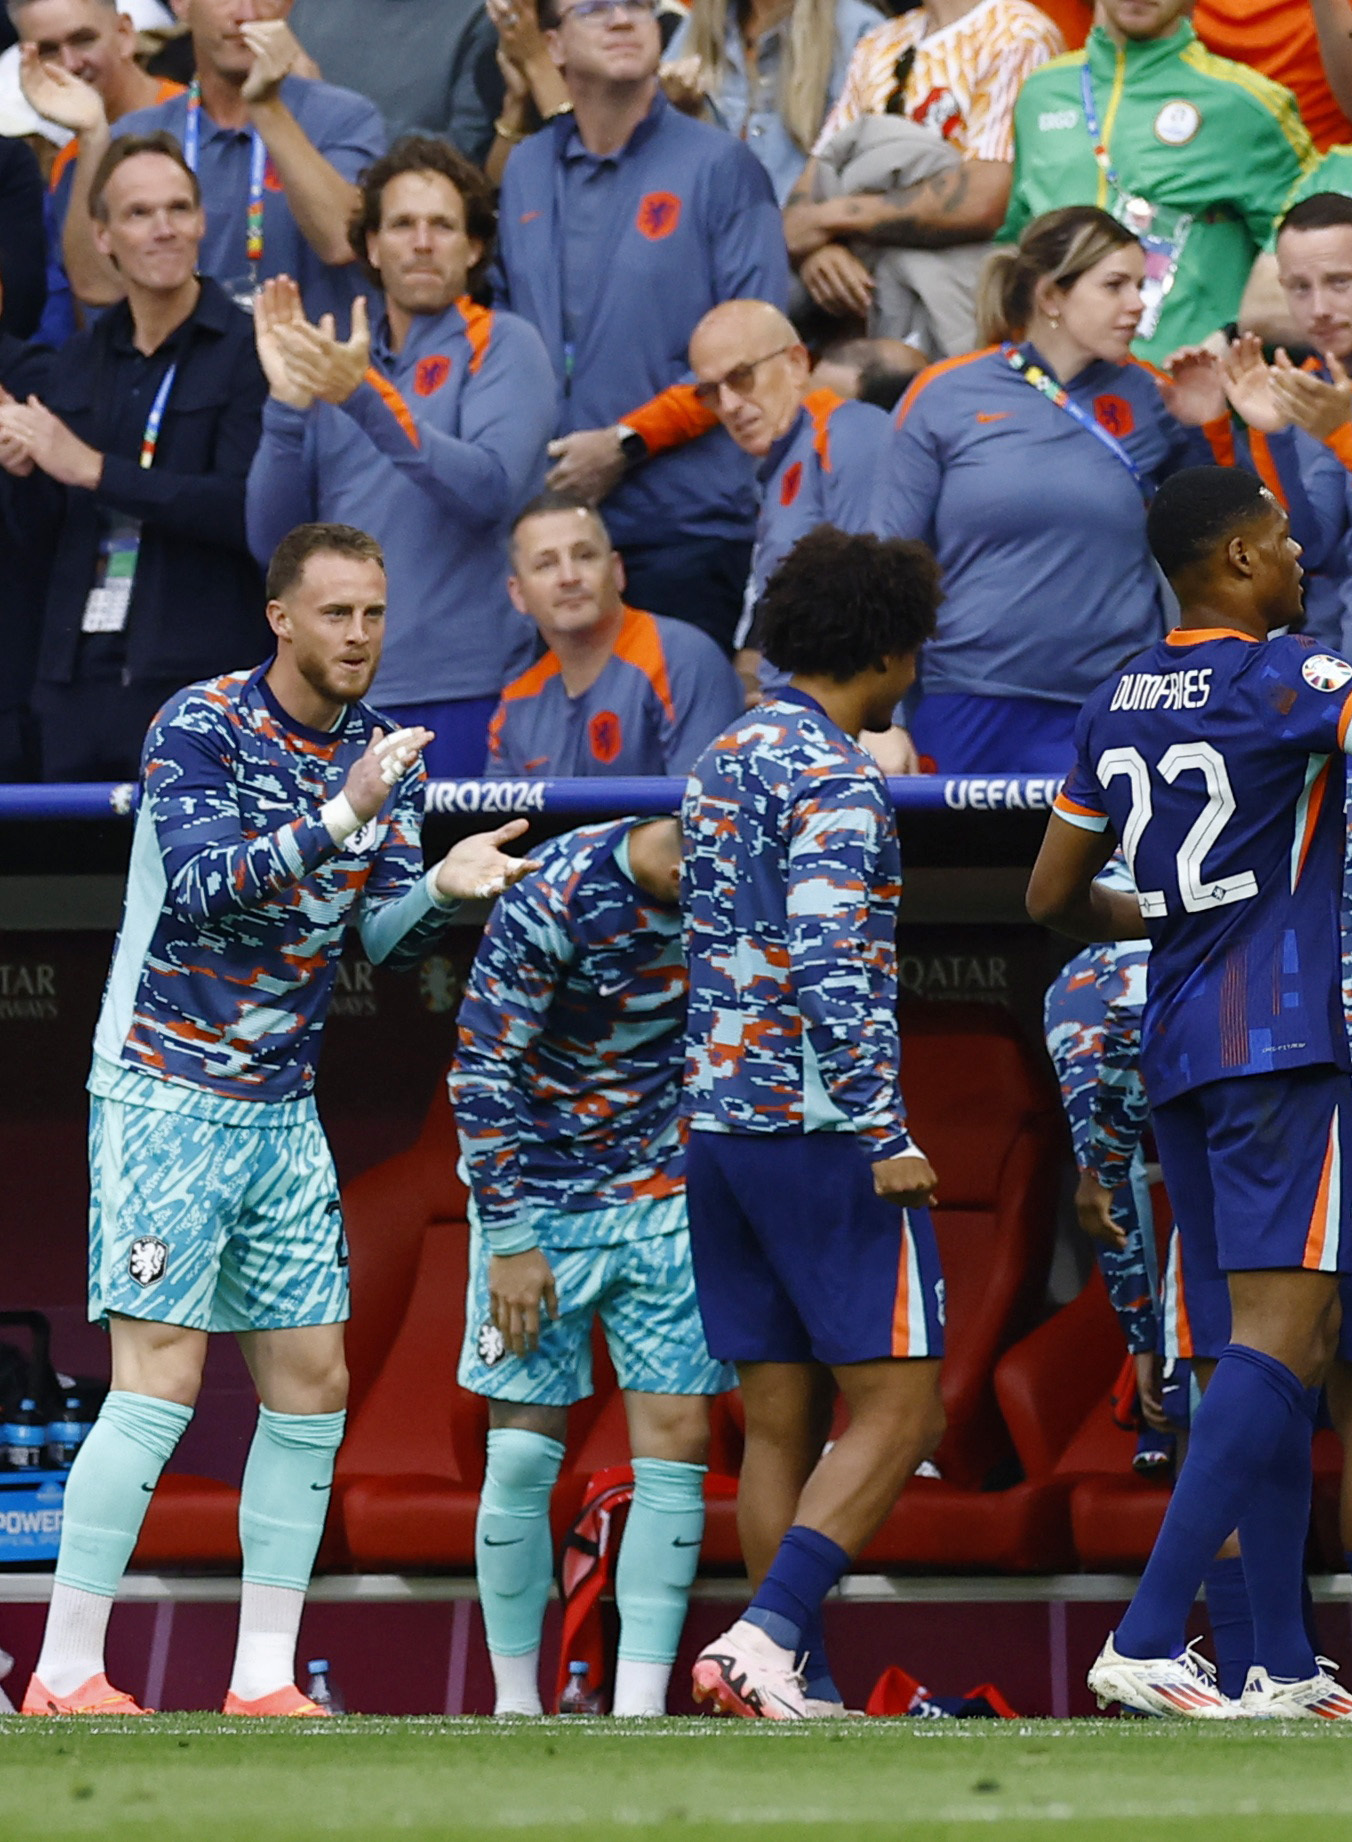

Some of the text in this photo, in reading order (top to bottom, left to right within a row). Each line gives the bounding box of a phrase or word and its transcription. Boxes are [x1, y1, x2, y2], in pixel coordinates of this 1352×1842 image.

[1109, 668, 1213, 711] DUMFRIES
[1096, 740, 1259, 919] 22
[898, 956, 1008, 995] QATAR
